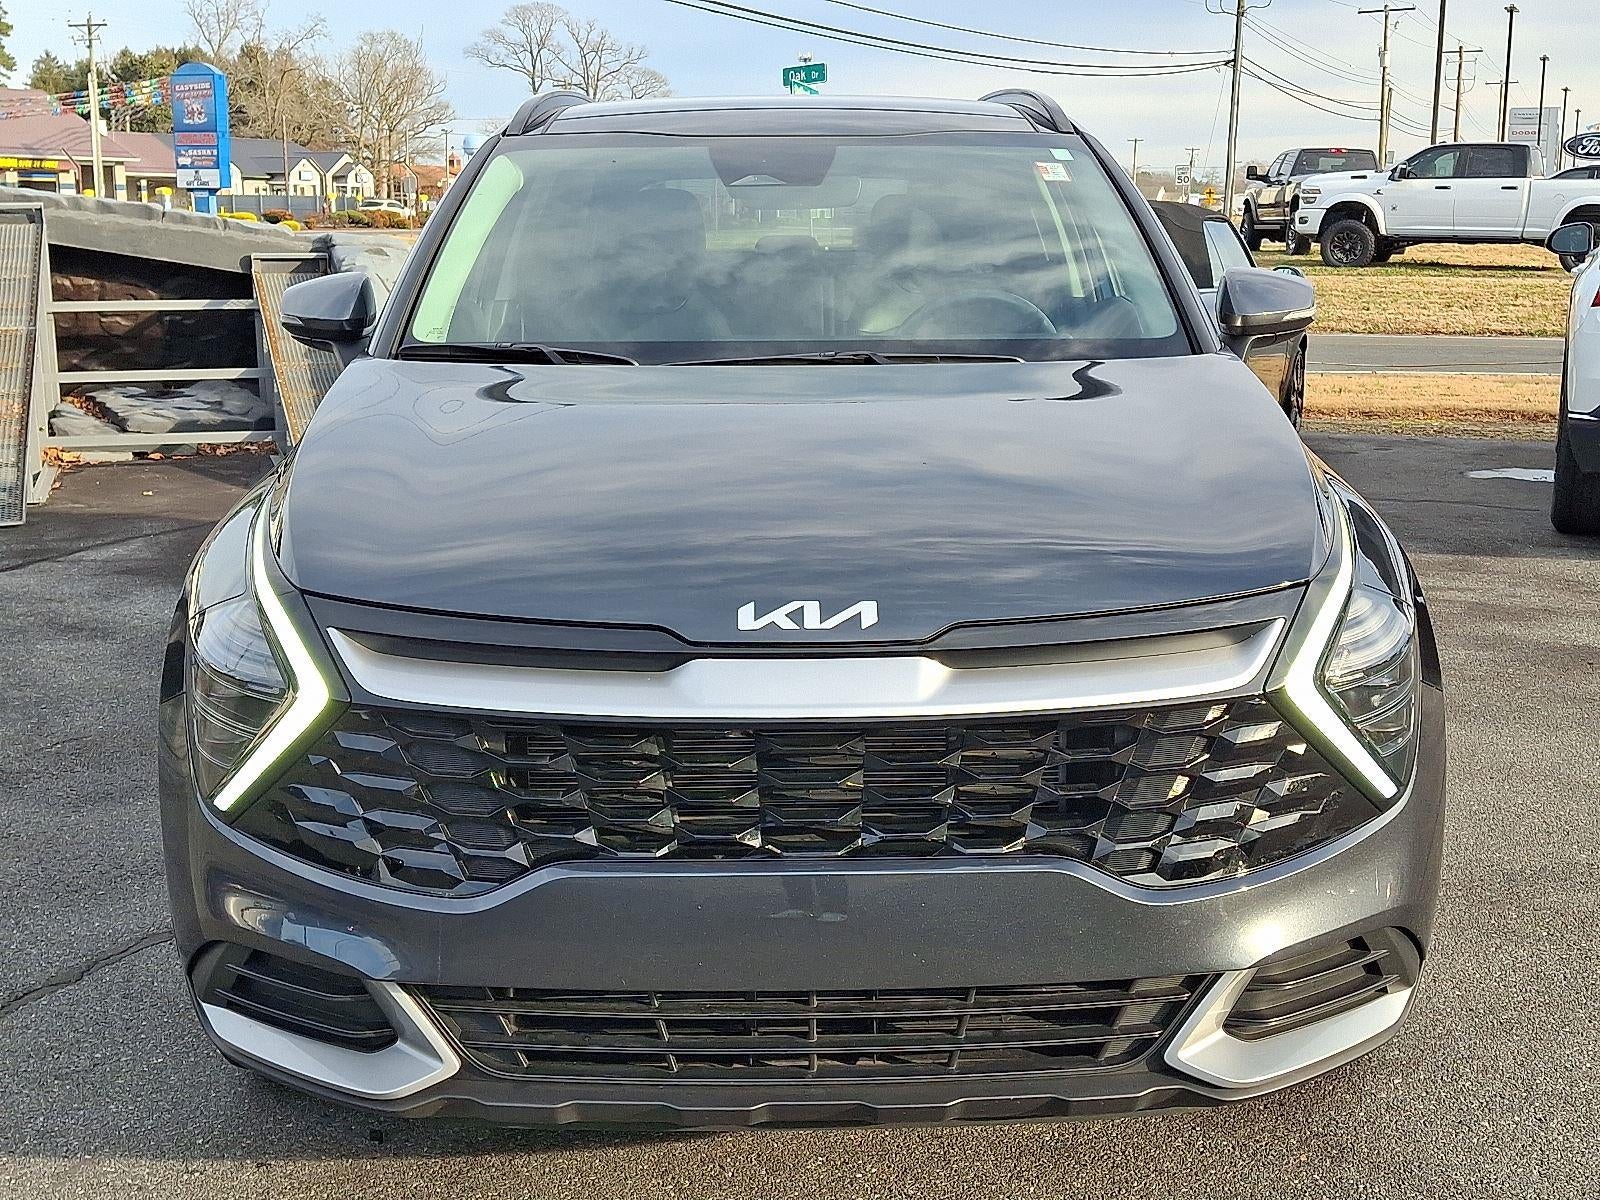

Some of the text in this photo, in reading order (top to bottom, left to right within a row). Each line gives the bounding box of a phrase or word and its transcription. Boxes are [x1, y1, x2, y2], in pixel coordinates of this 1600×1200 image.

[789, 69, 819, 81] Oak Dr
[175, 82, 211, 91] EASTSIDE
[1577, 137, 1600, 154] Fo
[1177, 175, 1189, 184] 50
[737, 600, 878, 631] KIA
